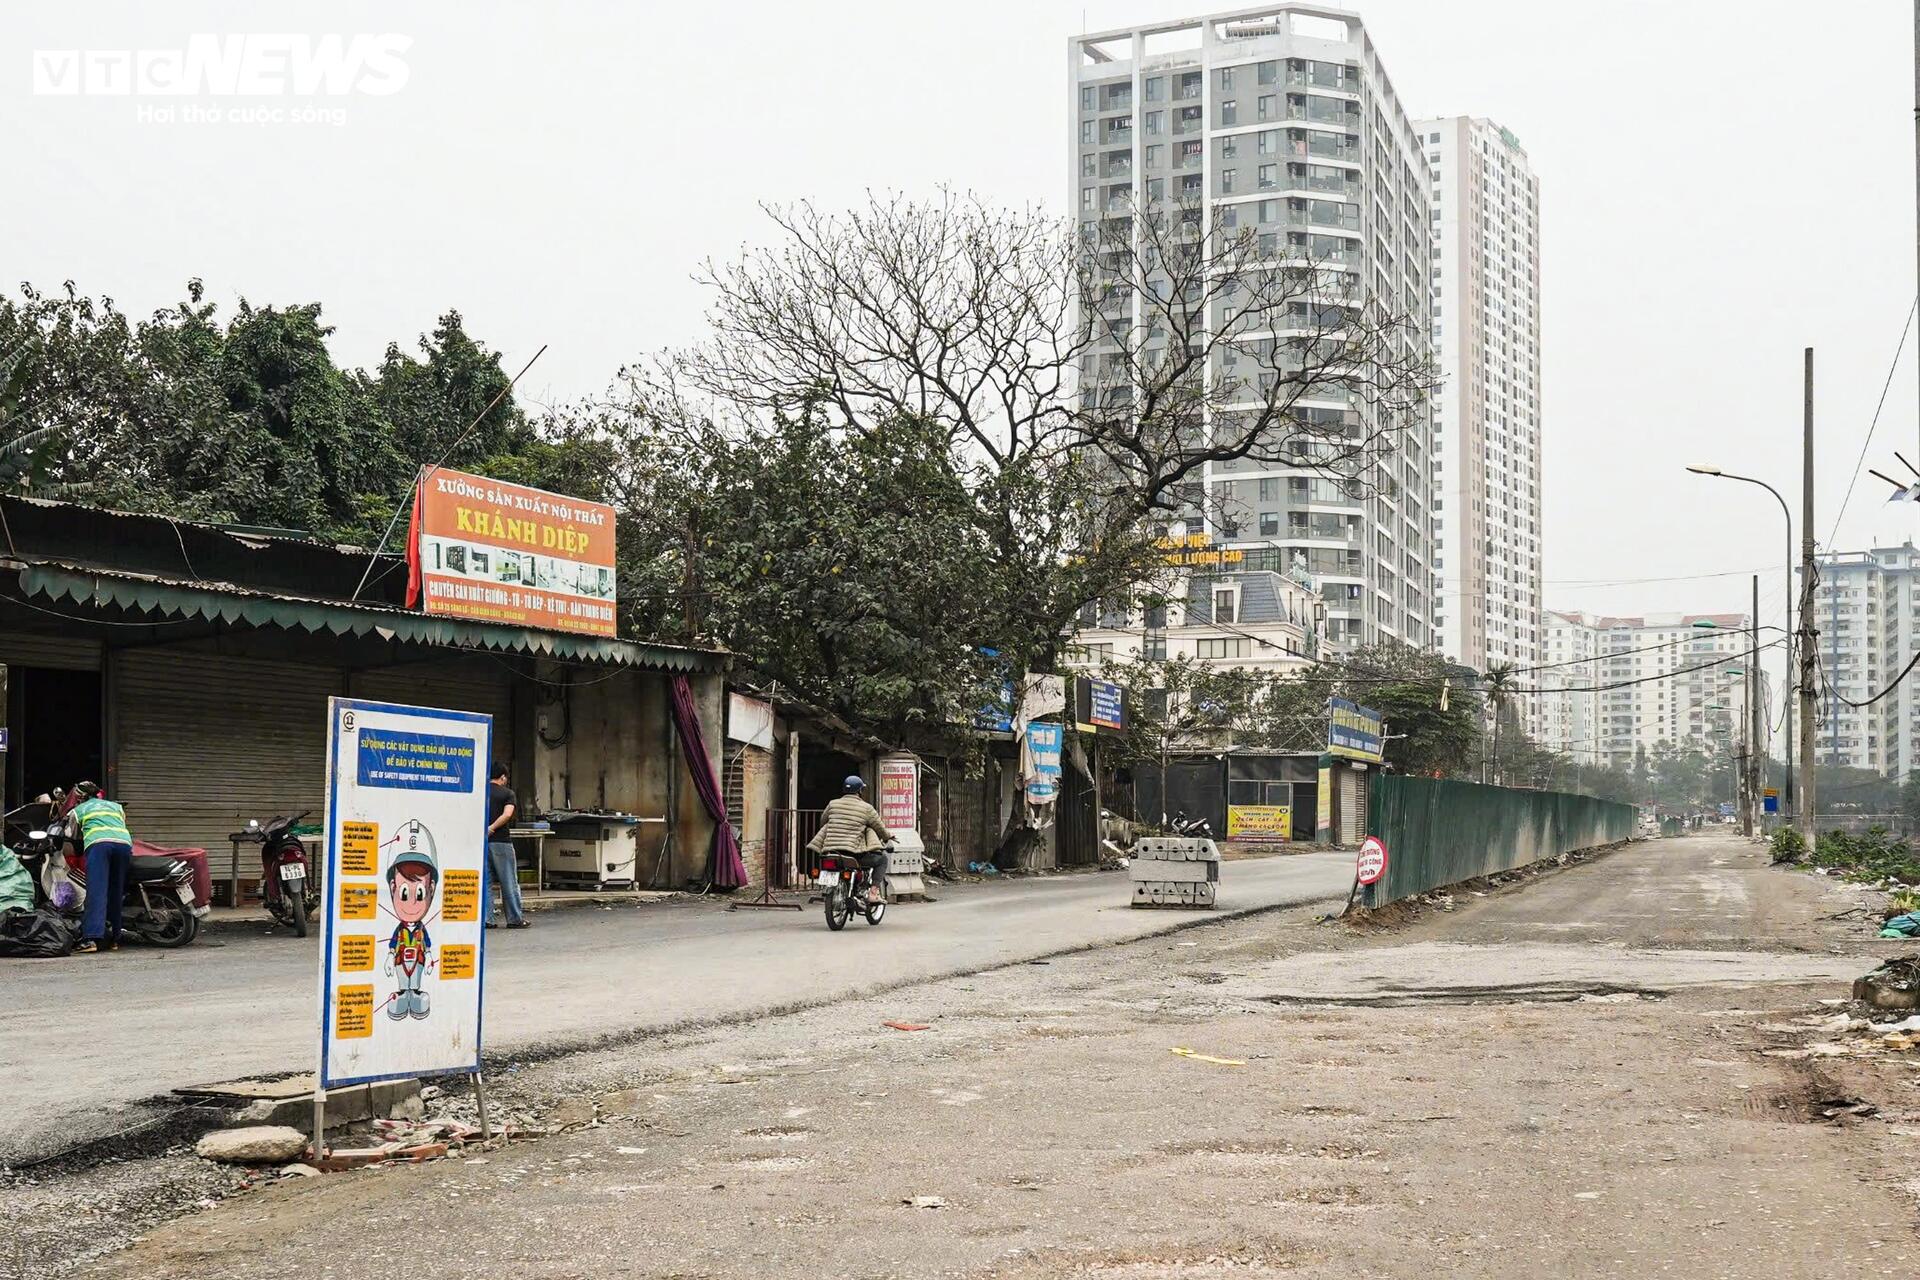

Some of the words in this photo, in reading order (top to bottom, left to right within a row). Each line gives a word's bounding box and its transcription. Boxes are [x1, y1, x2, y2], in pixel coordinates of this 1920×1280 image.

[437, 478, 484, 499] XƯỞNG
[487, 487, 512, 506] SẢN
[515, 496, 549, 514] XUẤT
[551, 505, 572, 521] NỘI
[575, 508, 604, 525] THẤT
[542, 524, 590, 558] DIỆP
[1222, 550, 1243, 562] CAO
